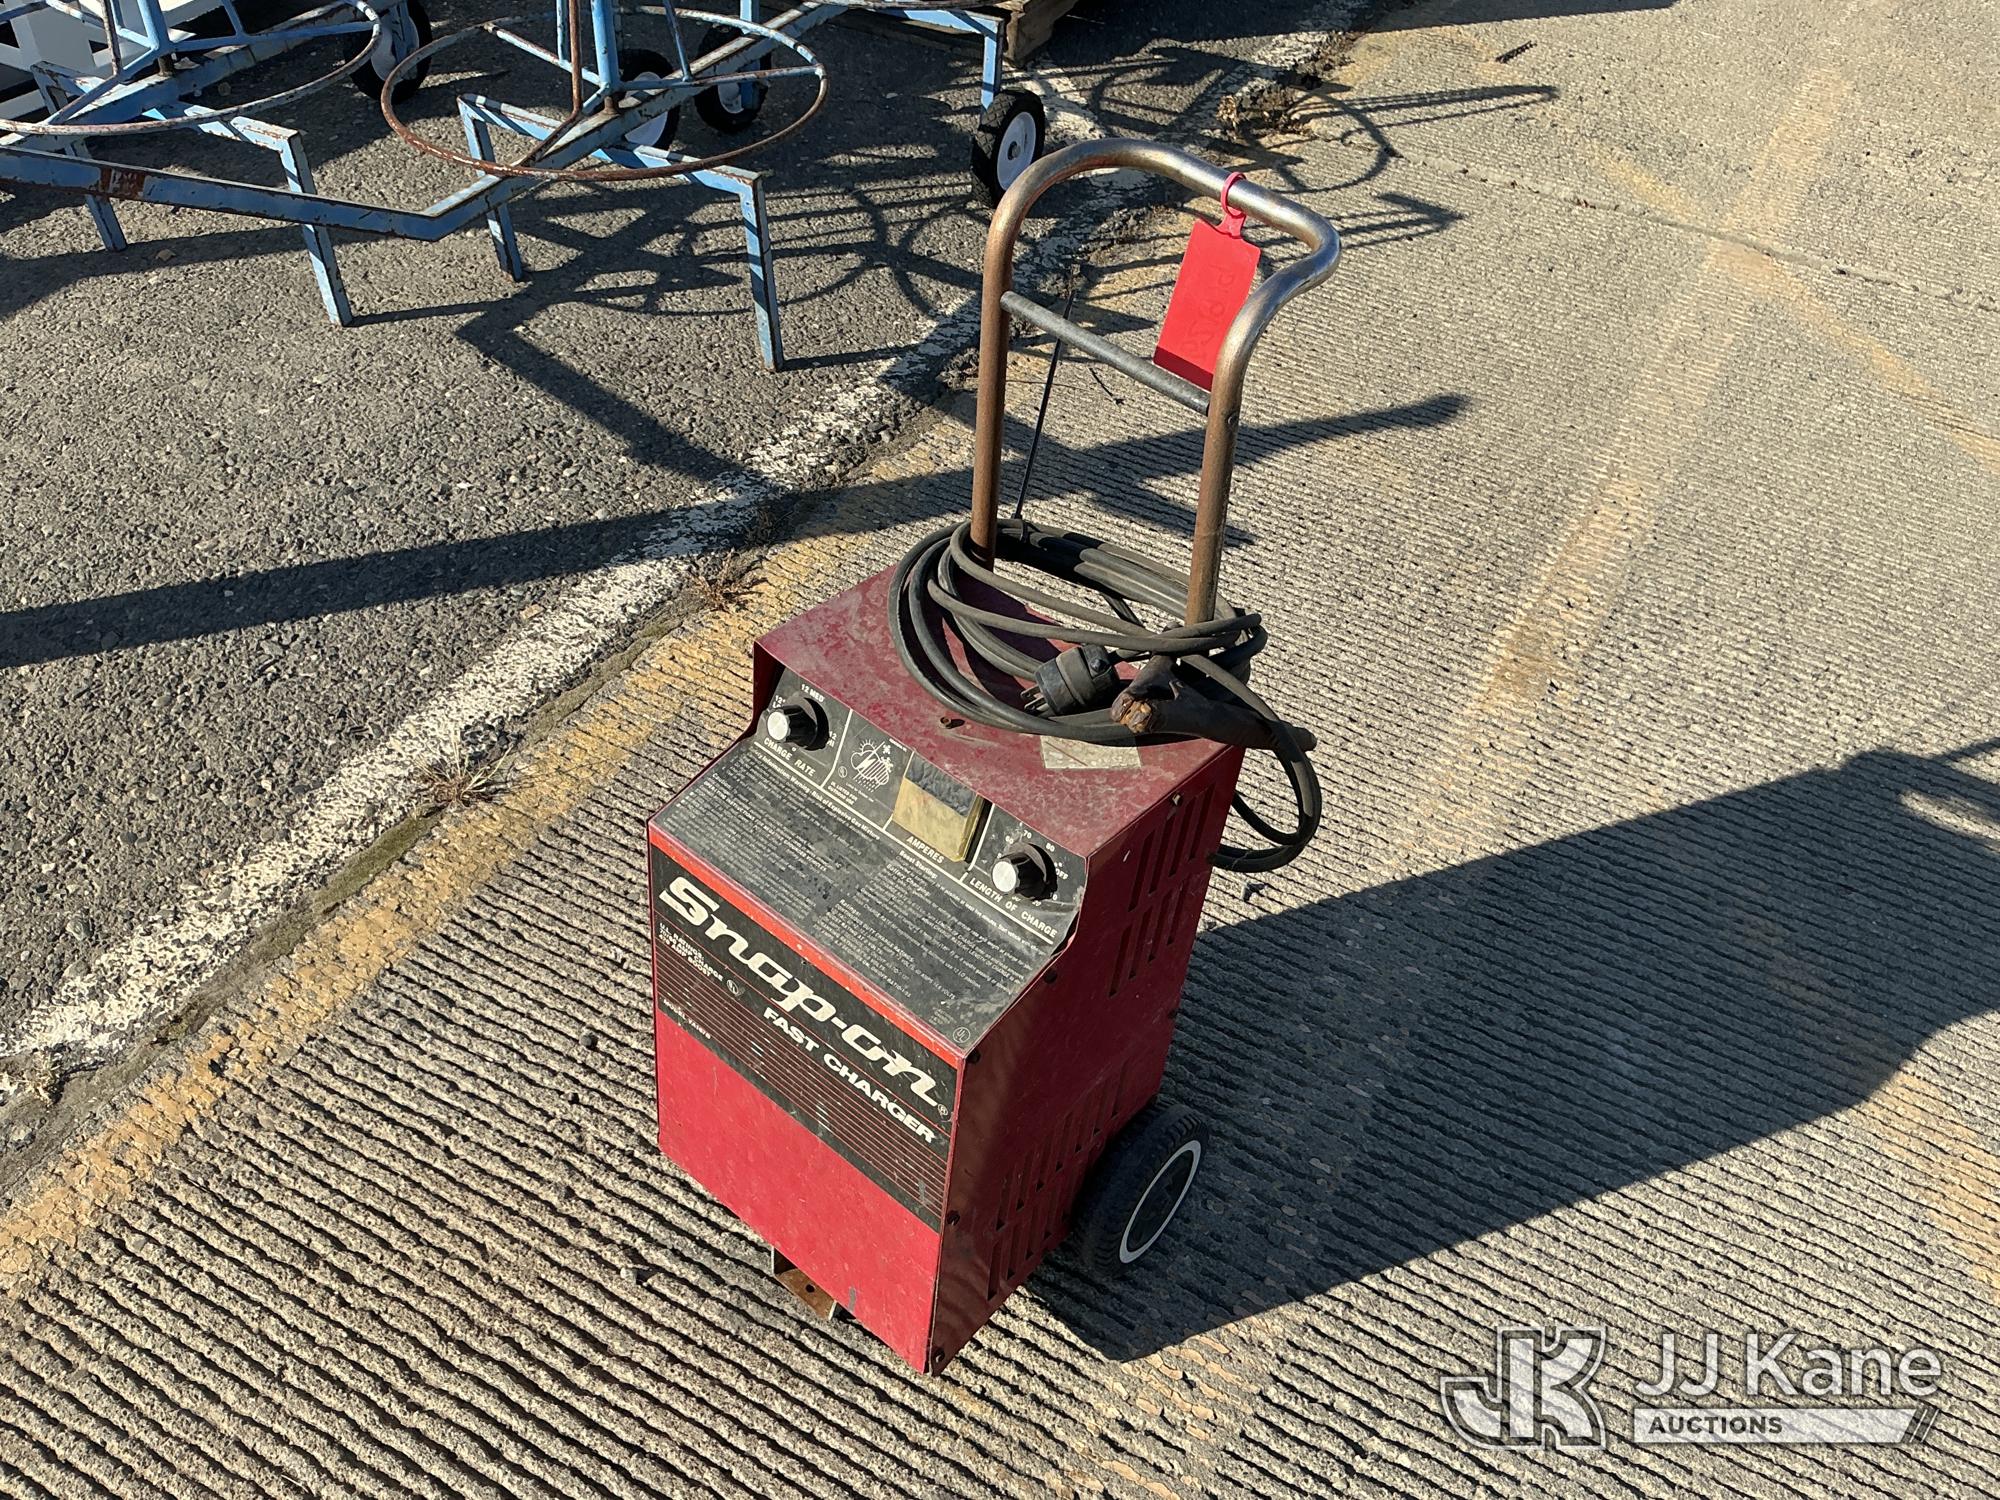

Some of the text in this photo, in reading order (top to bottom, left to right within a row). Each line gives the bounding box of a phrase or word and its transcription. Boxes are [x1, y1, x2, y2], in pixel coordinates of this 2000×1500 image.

[801, 684, 825, 703] 12 MED
[763, 737, 793, 760] CHARGE
[794, 759, 816, 777] RATE
[1005, 835, 1014, 845] 60
[1023, 829, 1032, 839] 70
[1045, 842, 1055, 852] 80
[906, 835, 945, 864] AMPERES
[969, 877, 1003, 903] LENGTH
[1005, 900, 1018, 912] OF
[1021, 911, 1058, 938] CHARGE
[688, 956, 710, 976] BOOST
[694, 955, 723, 981] CHARGE
[659, 876, 939, 1108] Snap-on
[763, 1007, 936, 1144] FAST CHARGER
